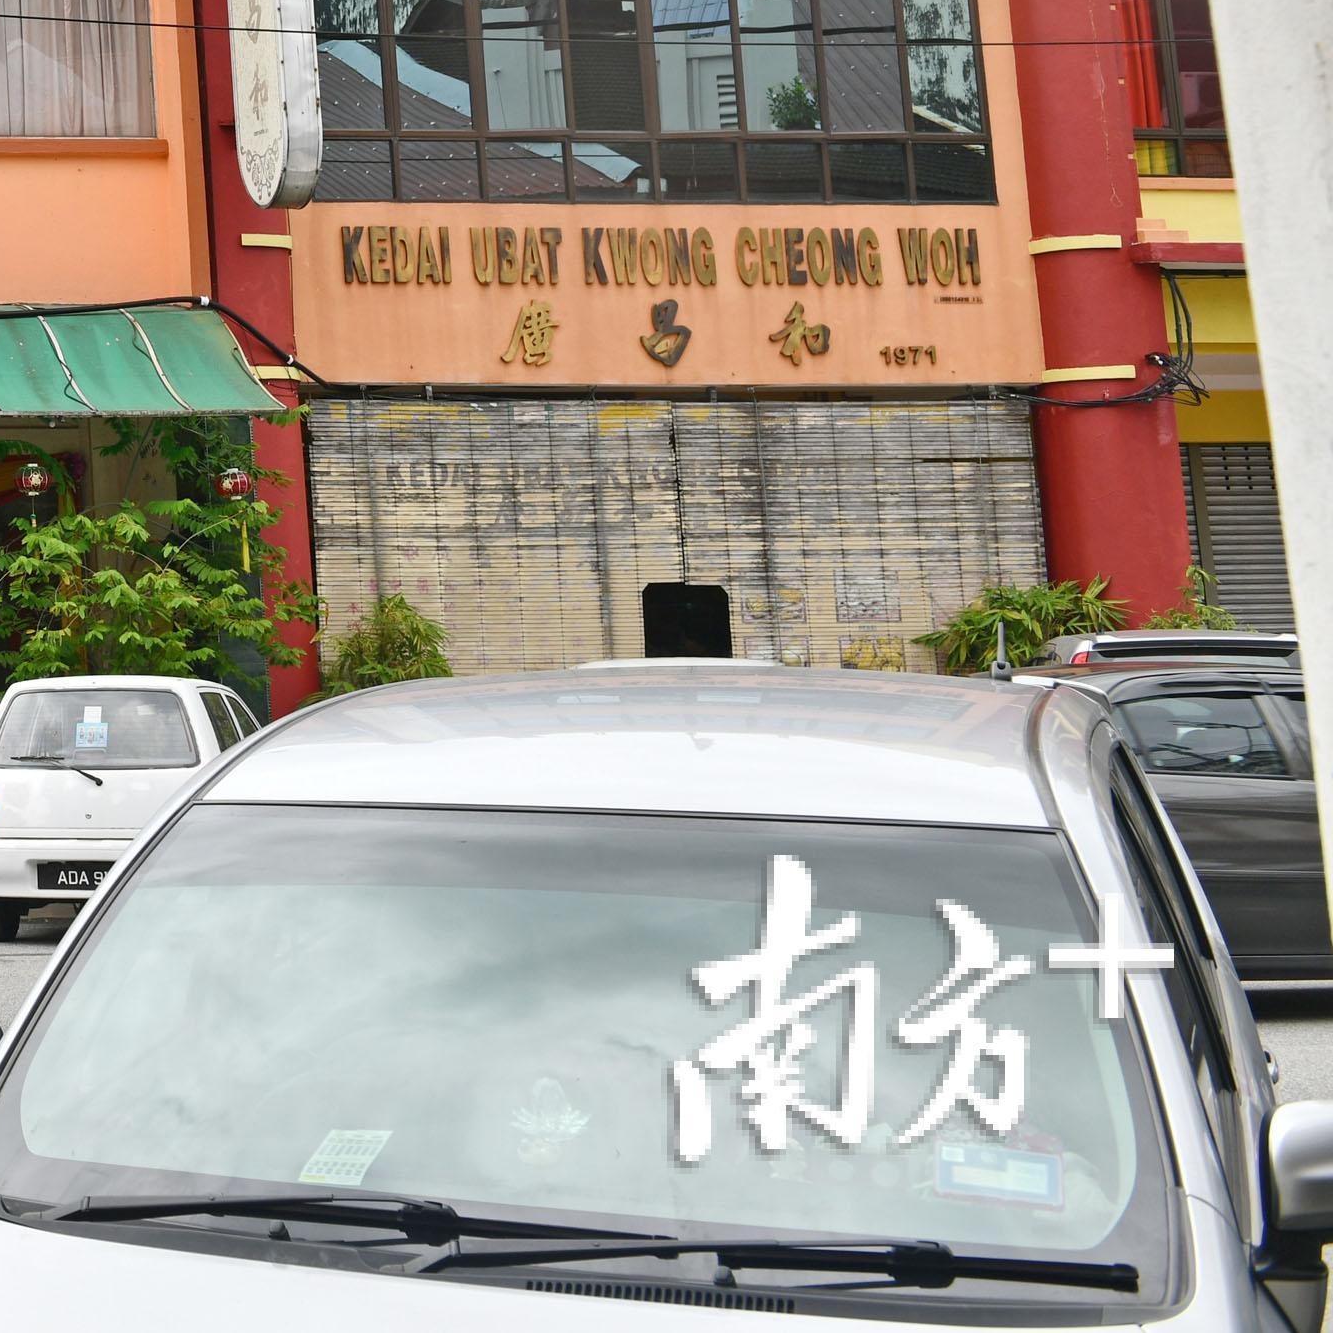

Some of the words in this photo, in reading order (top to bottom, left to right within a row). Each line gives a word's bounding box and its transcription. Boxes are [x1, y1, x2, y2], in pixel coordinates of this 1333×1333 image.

[341, 226, 453, 284] KEDAI
[469, 227, 562, 286] UBAT
[581, 226, 717, 287] KWONG
[735, 226, 883, 287] CHEONG
[897, 227, 981, 287] WOH
[880, 344, 937, 366] 1971
[57, 870, 90, 885] ADA
